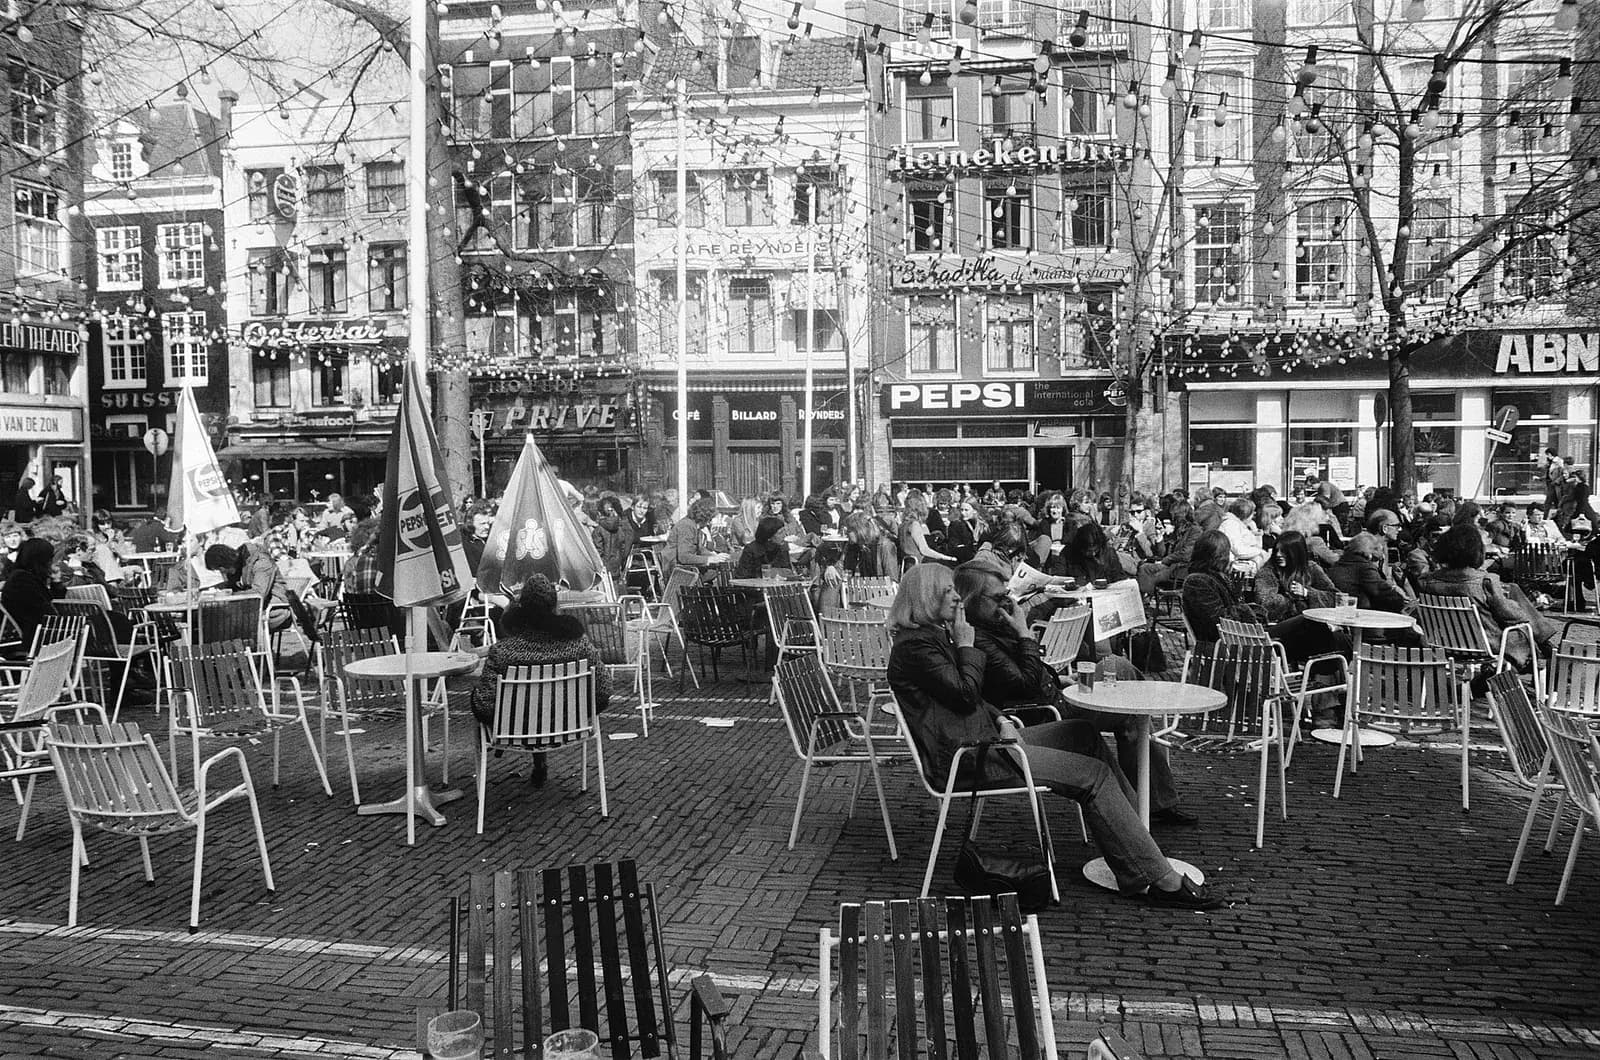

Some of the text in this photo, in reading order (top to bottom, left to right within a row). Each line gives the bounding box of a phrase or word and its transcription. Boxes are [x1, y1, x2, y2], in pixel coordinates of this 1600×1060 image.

[890, 138, 1058, 170] Heineken
[0, 323, 80, 354] EIN THEATER
[243, 320, 385, 347] Oesterbar
[1495, 333, 1600, 373] ABN
[1034, 382, 1050, 390] the
[891, 382, 1025, 409] PEPSI
[1034, 390, 1094, 399] international
[1073, 398, 1094, 406] cola
[503, 397, 619, 430] PRIVÉ
[672, 409, 701, 421] CFÉ
[731, 409, 778, 421] BILLARD
[798, 408, 845, 421] RYNDERS
[3, 416, 59, 432] VAN DE ZON
